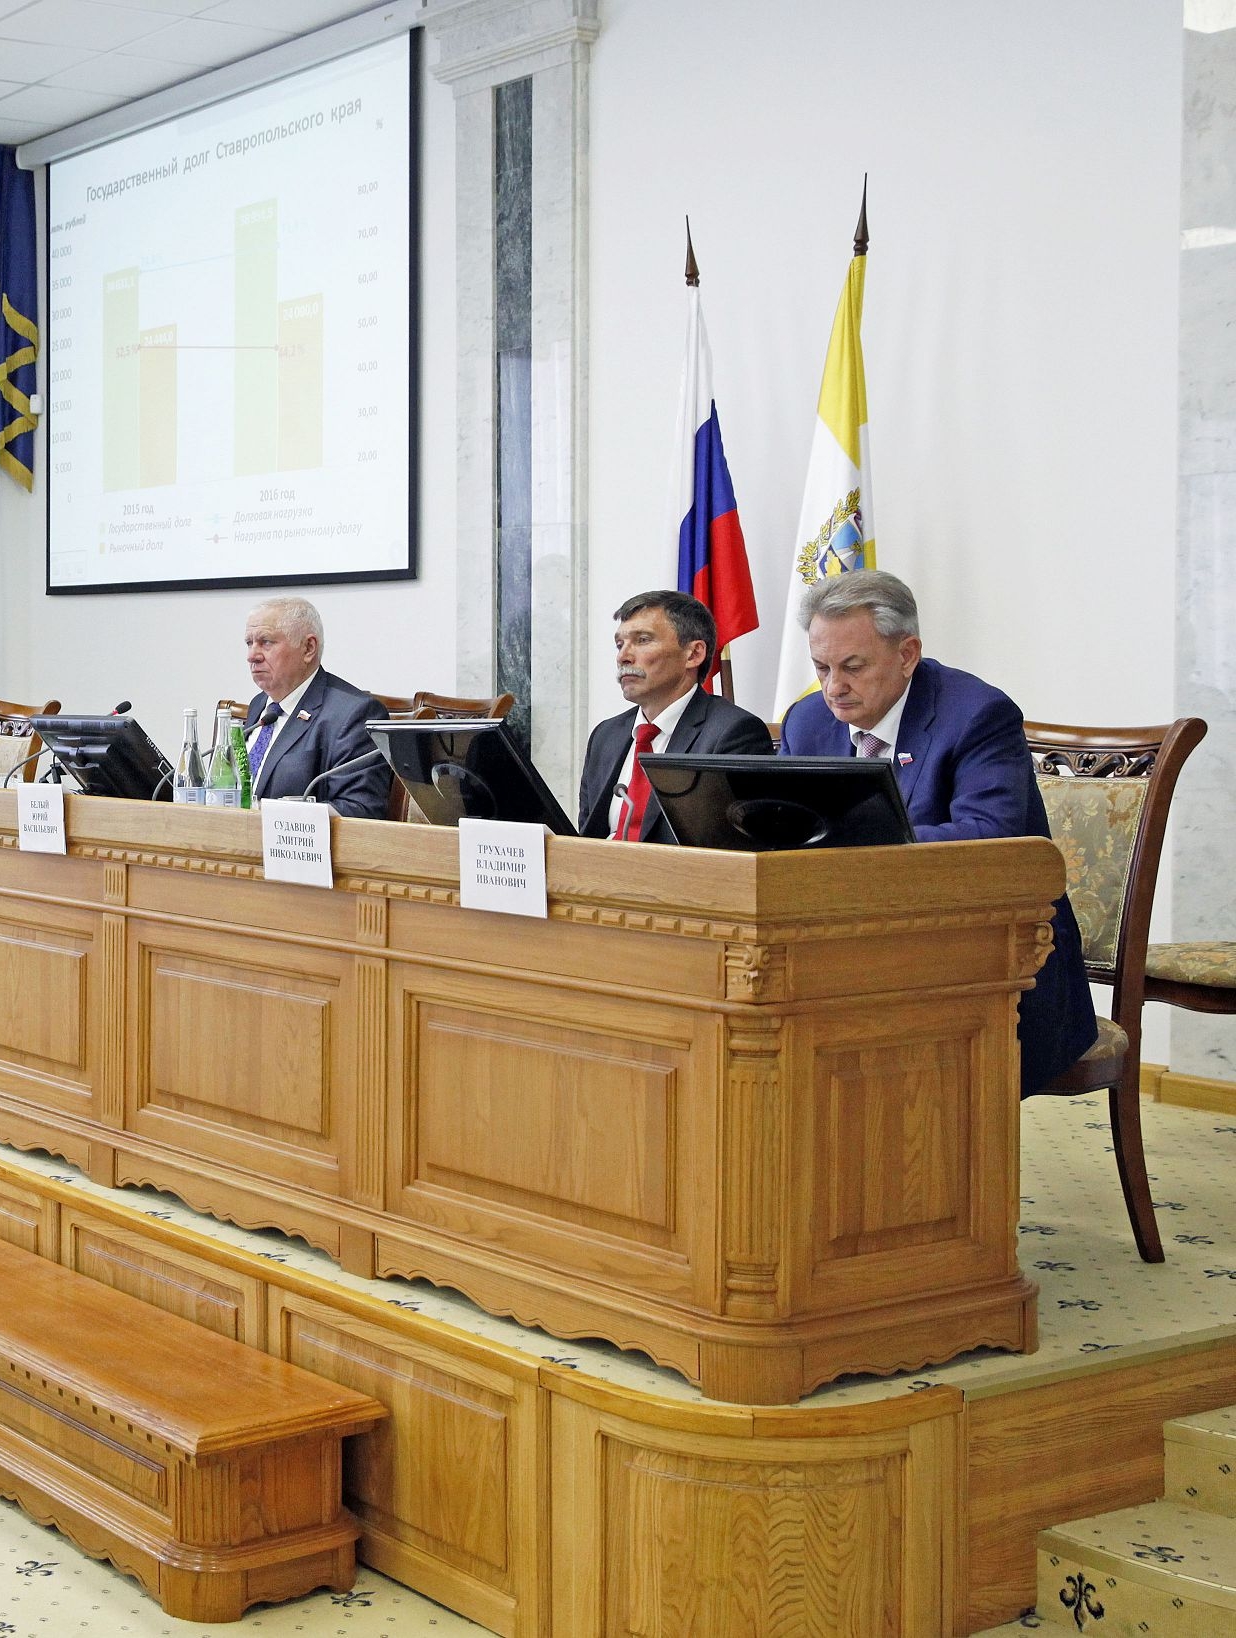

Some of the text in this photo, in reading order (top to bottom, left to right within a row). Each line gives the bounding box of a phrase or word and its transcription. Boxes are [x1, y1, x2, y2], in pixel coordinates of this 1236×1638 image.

[86, 96, 363, 204] Государственный долг Ставропольского края
[357, 181, 379, 196] 80,00
[357, 225, 379, 240] 70,00
[357, 271, 379, 285] 60,00
[357, 315, 379, 329] 50,00
[357, 360, 379, 373] 40,00
[357, 406, 379, 418] 30,00
[357, 450, 378, 462] 20,00
[259, 489, 296, 502] 2016 год
[123, 504, 155, 516] 2015 год
[233, 505, 313, 524] Долговая нагрузка
[108, 516, 192, 536] Государственный долг
[233, 521, 362, 544] Нагрузка по рыночному долгу
[109, 539, 164, 554] Рыночный долг
[30, 799, 50, 809] БЕЛЫЙ
[32, 812, 49, 821] ЮРИЙ
[23, 824, 58, 834] ВАСИЛЬЕВИЧ
[274, 821, 316, 834] СУДАВЦОВ
[276, 835, 314, 848] ДМИТРИЙ
[269, 848, 322, 863] НИКОЛАЕВИЧ
[477, 844, 525, 858] ТРУХАЧЕВ
[476, 859, 527, 873] ВЛАДИМИР
[476, 874, 526, 888] ИВАНОВИЧ
